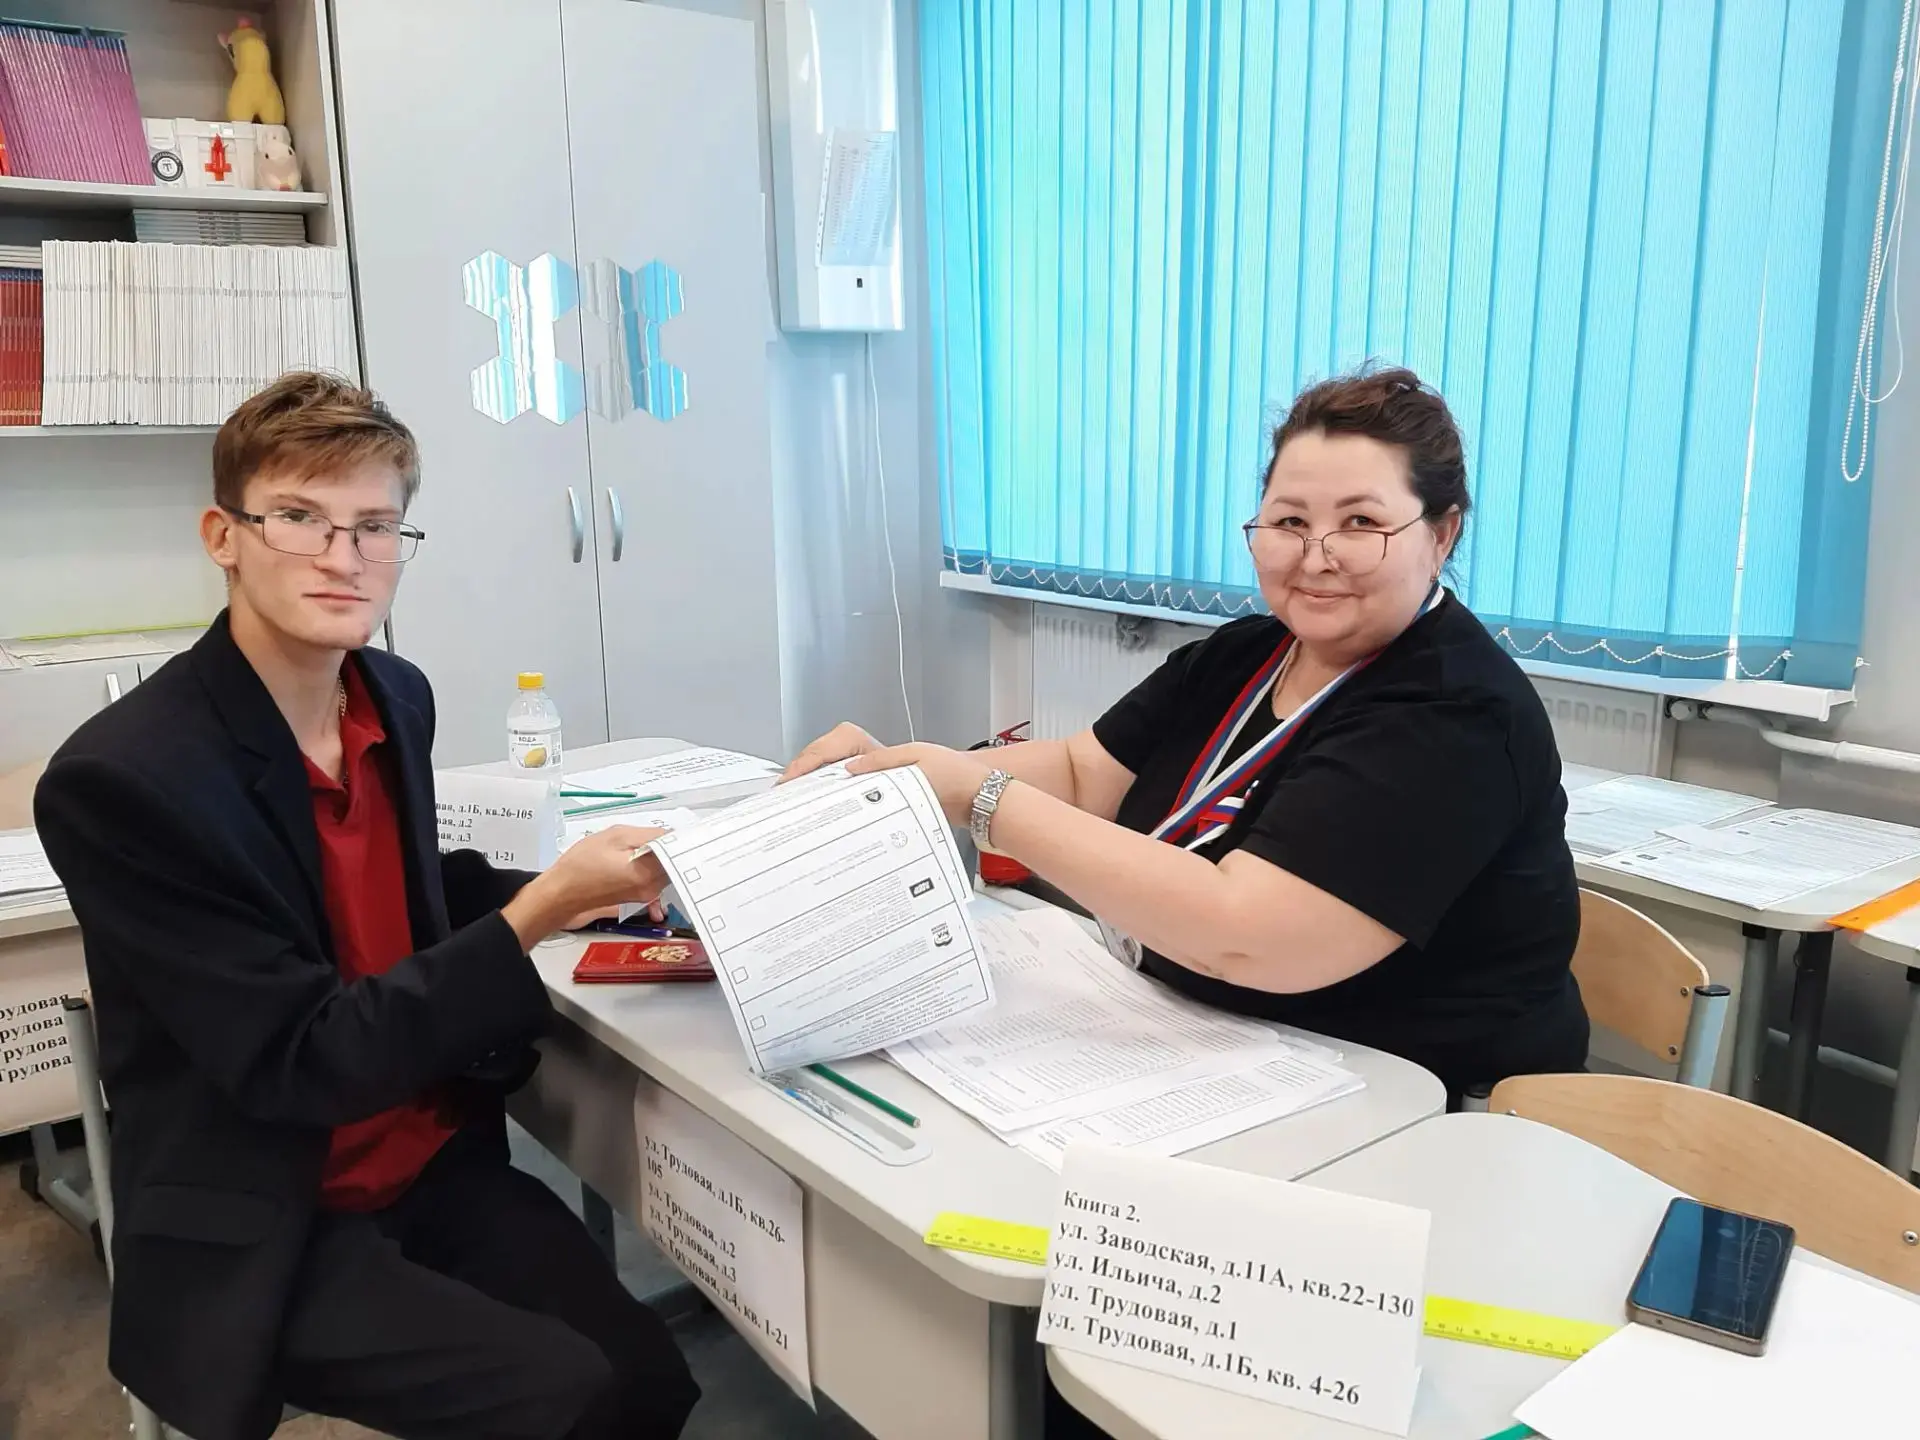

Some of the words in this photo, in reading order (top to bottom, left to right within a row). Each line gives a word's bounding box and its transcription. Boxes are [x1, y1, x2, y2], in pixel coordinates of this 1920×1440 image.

[457, 833, 472, 842] д.3
[458, 818, 473, 828] д.2
[485, 807, 534, 820] кв.26-105
[645, 1135, 660, 1154] ул.
[661, 1143, 716, 1198] Трудовая,
[718, 1187, 747, 1221] д.1Б,
[750, 1210, 785, 1243] кв.26-
[647, 1155, 663, 1180] 105
[648, 1181, 663, 1202] ул.
[664, 1190, 718, 1247] Трудовая,
[720, 1238, 736, 1259] д.2
[1064, 1190, 1120, 1218] Книга
[1125, 1204, 1141, 1223] 2.
[665, 1214, 719, 1272] Трудовая,
[721, 1263, 737, 1283] д.3
[1053, 1251, 1083, 1271] ул.
[1091, 1255, 1183, 1298] Ильича,
[1188, 1284, 1222, 1304] д.2
[1058, 1221, 1088, 1241] ул.
[1096, 1225, 1216, 1275] Заводская,
[1221, 1260, 1293, 1293] д.11А,
[1302, 1277, 1414, 1318] кв.22-130
[721, 1287, 741, 1313] д.4,
[744, 1303, 761, 1329] кв.
[764, 1318, 788, 1351] 1-21
[1049, 1281, 1079, 1301] ул.
[1087, 1285, 1199, 1334] Трудовая,
[1205, 1321, 1237, 1341] д.1
[1045, 1311, 1075, 1331] ул.
[1083, 1315, 1195, 1365] Трудовая,
[1201, 1352, 1258, 1382] д.1Б,
[1266, 1368, 1301, 1390] кв.
[1309, 1375, 1361, 1405] 4-26
